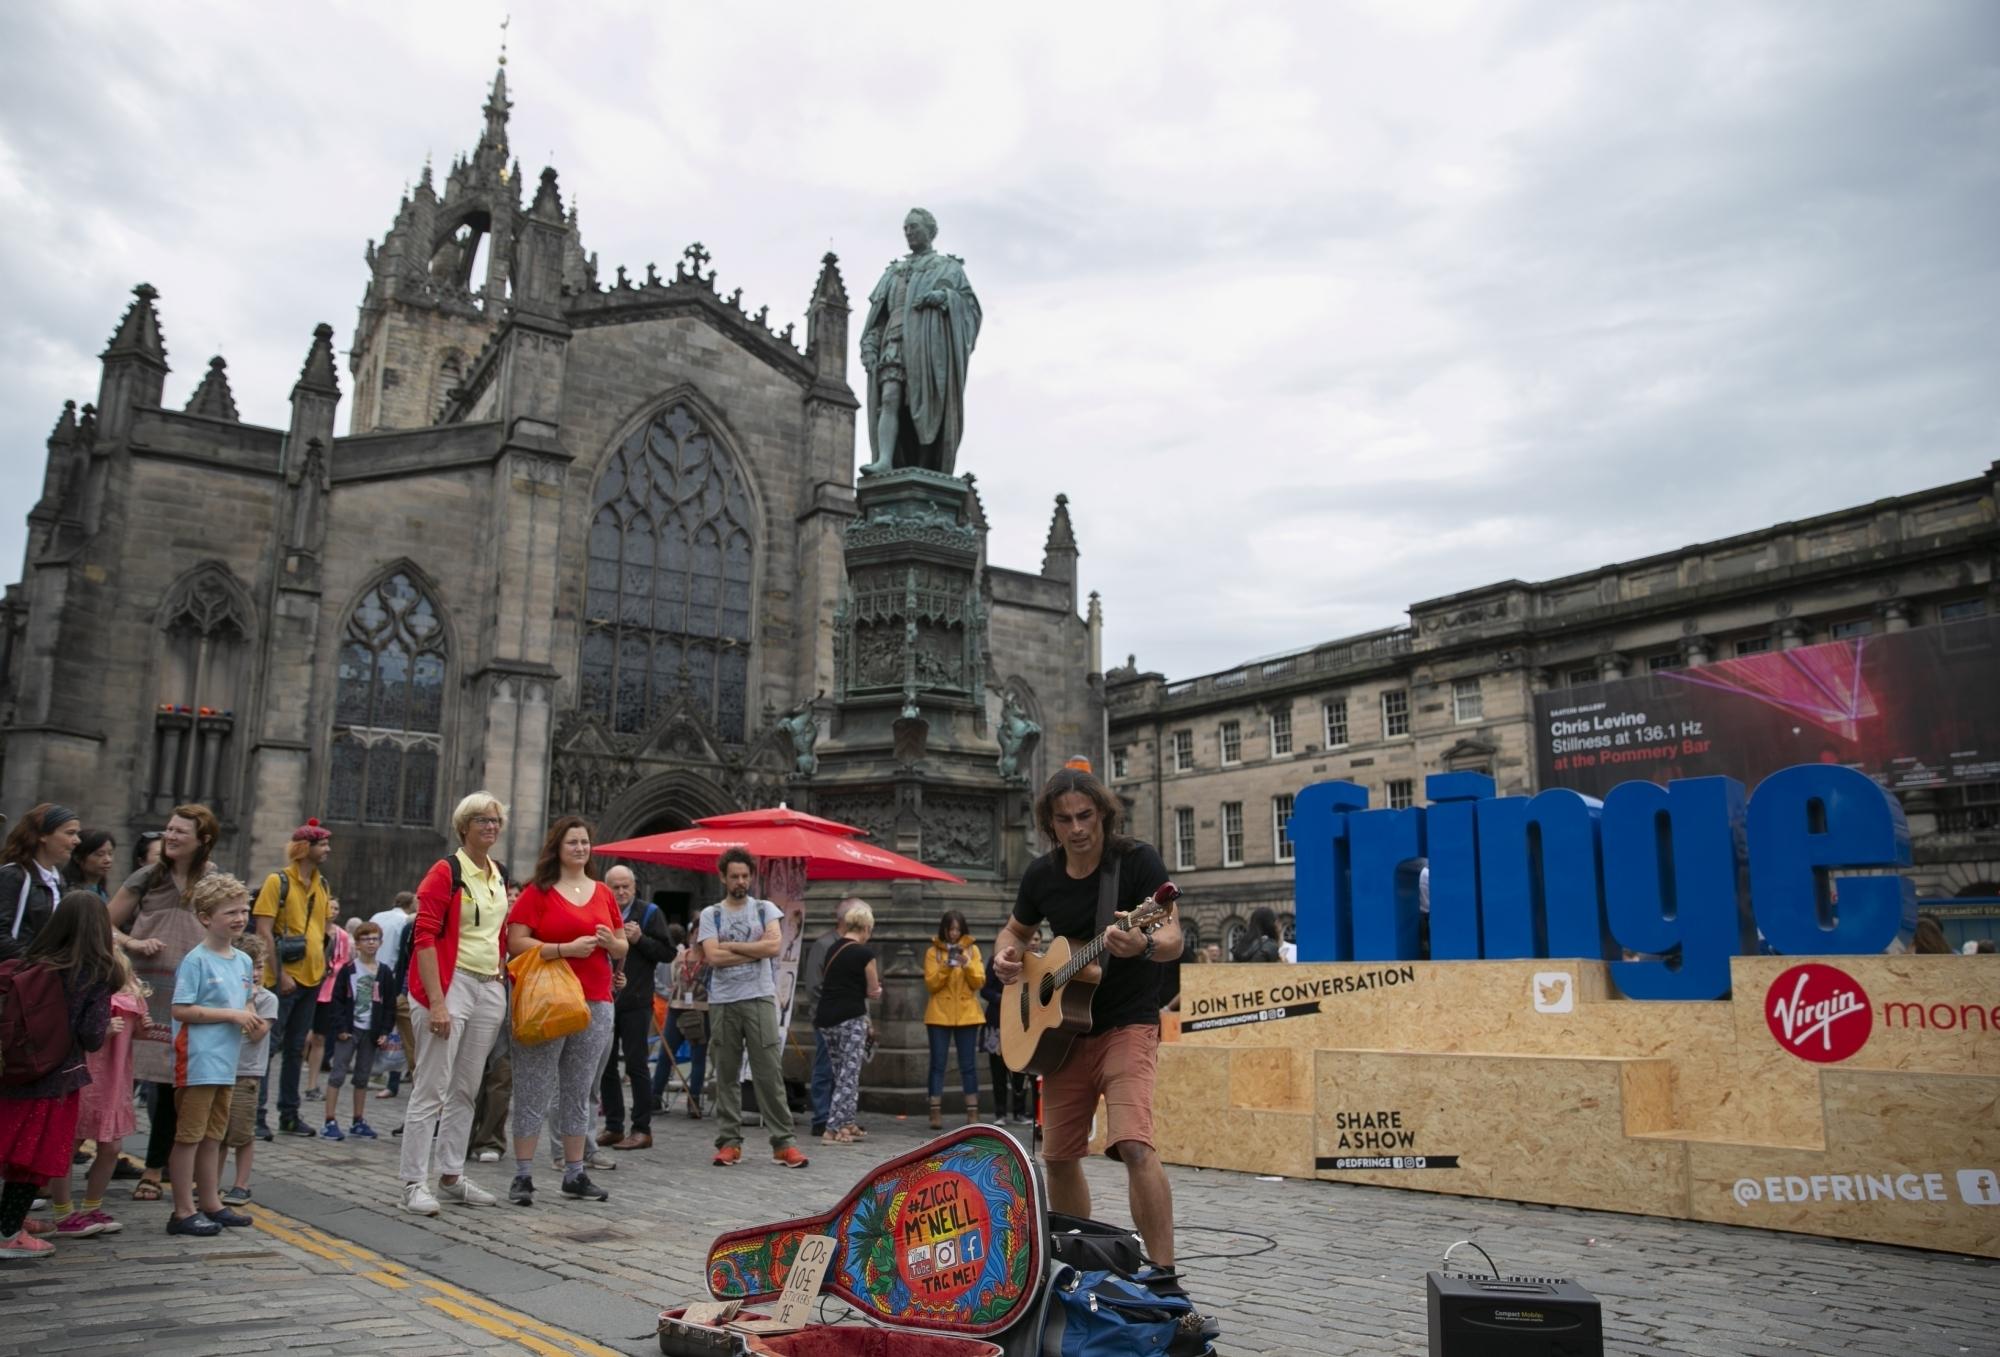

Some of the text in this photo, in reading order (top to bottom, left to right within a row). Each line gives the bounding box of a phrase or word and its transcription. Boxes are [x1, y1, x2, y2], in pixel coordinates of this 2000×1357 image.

[1551, 712, 1646, 736] Chris Levine
[1552, 721, 1703, 753] Stillness at 136.1 Hz
[1554, 739, 1711, 770] at the Pommery Bar
[1288, 764, 1913, 1000] fringe
[1191, 966, 1415, 1016] JOIN THE CONVERSATION
[1774, 973, 1865, 1050] Virgin
[1336, 1111, 1402, 1129] SHARE
[1336, 1158, 1391, 1169] @EDFRINGE
[907, 1179, 959, 1214] #ZIGGY
[1733, 1173, 1948, 1207] @EDFRINGE
[801, 1241, 827, 1264] CDs
[790, 1266, 815, 1291] 10£
[910, 1262, 930, 1275] Tube
[922, 1265, 977, 1294] TAG ME!
[783, 1291, 812, 1306] STICKERS
[780, 1304, 794, 1323] 1£
